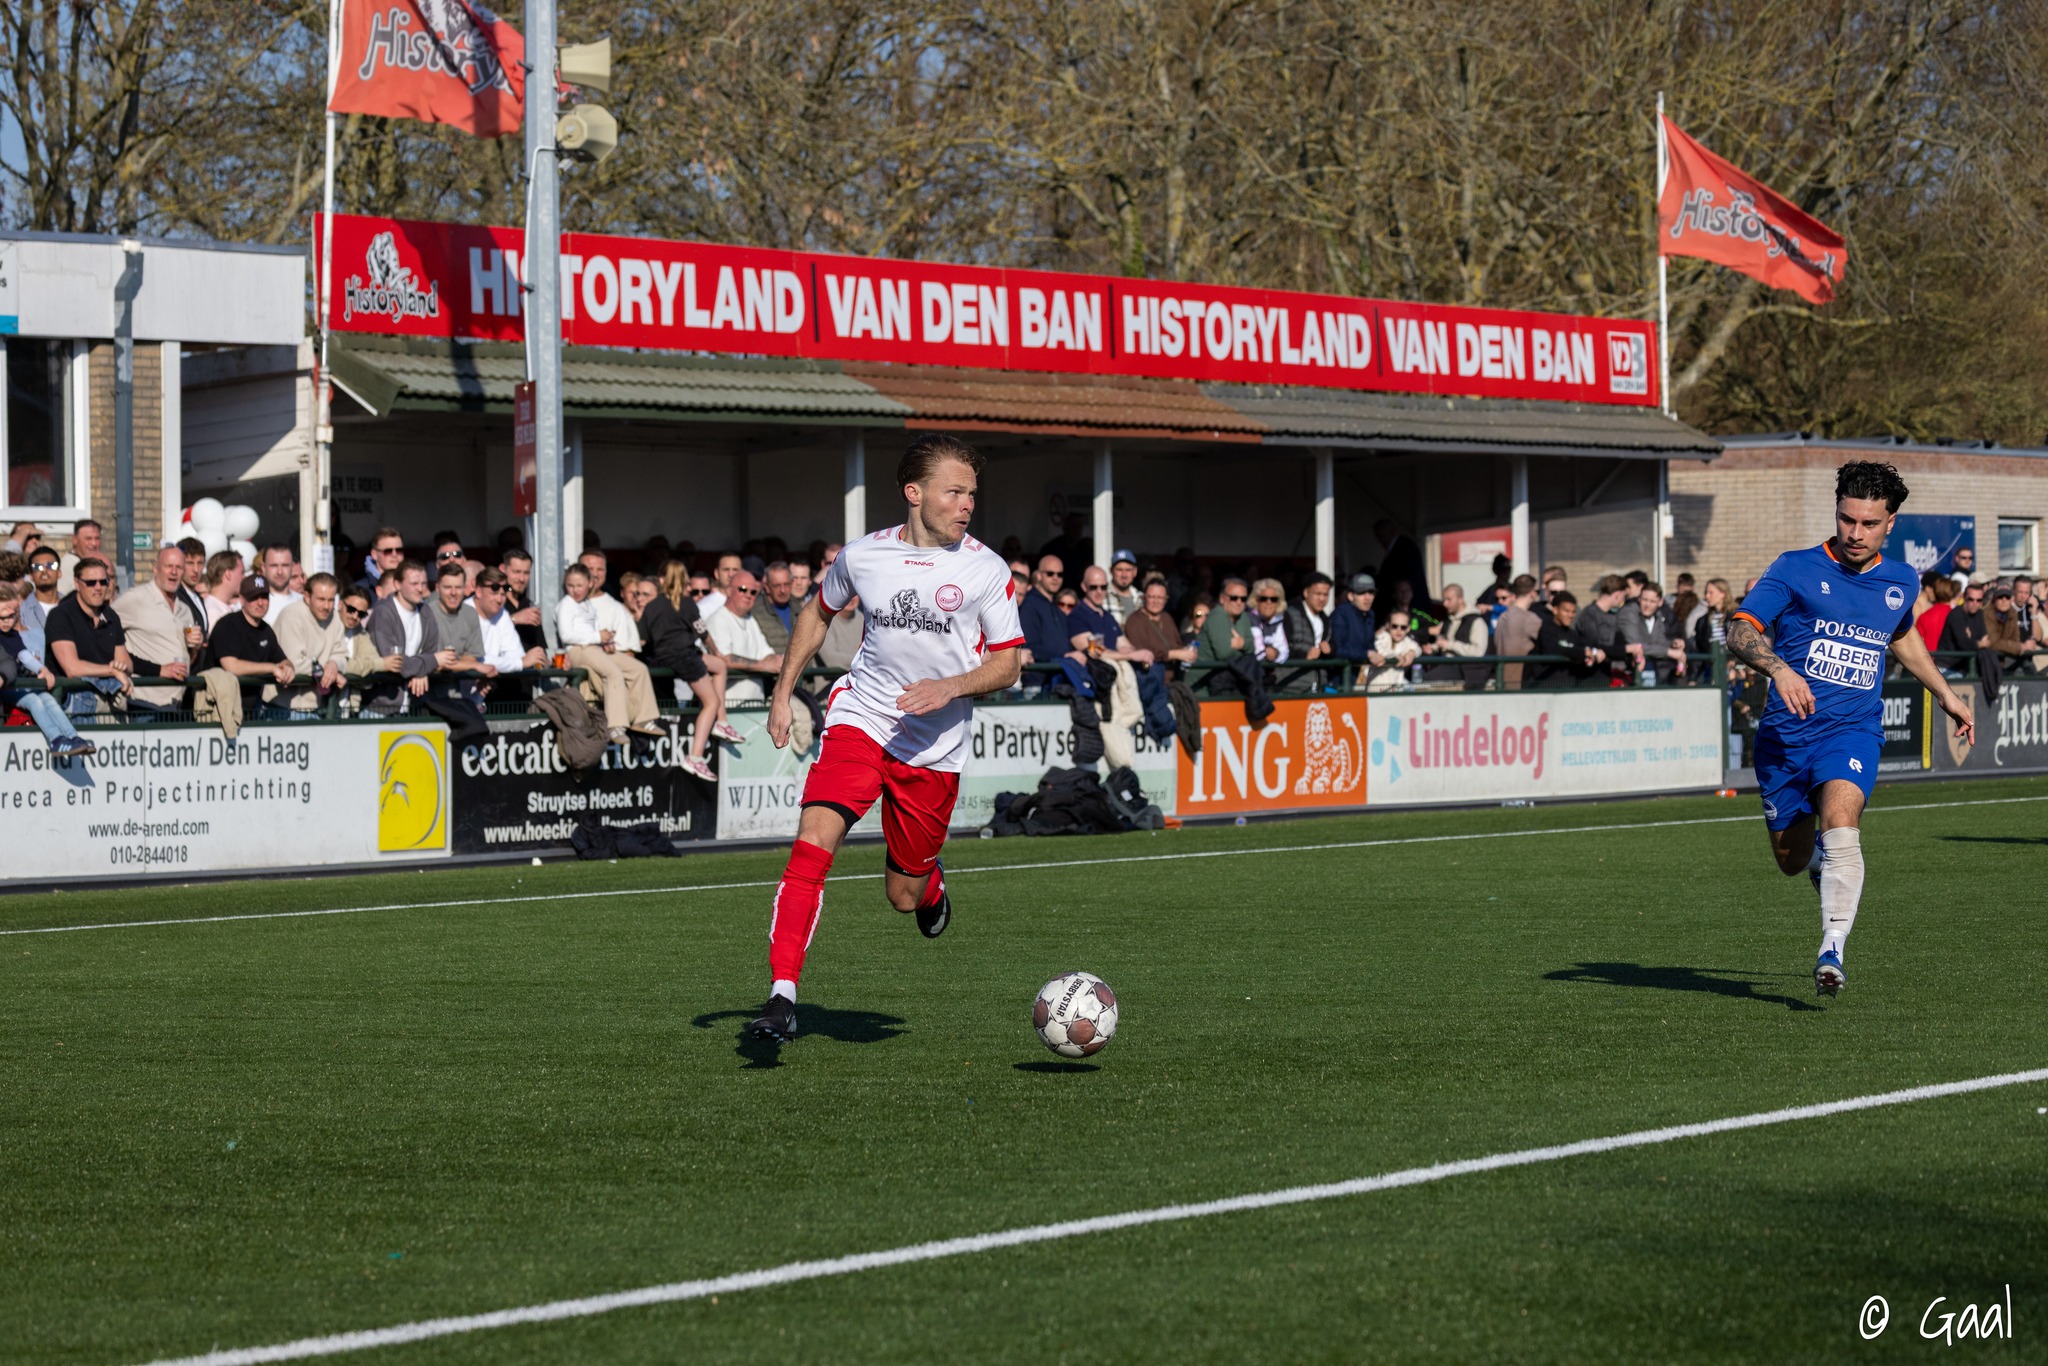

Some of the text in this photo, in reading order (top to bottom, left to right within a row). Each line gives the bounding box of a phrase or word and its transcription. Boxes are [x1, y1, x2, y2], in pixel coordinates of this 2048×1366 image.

[344, 274, 439, 323] Historyland
[469, 247, 805, 334] HITORYLAND
[824, 274, 1102, 351] VAN DEN BAN
[1122, 295, 1372, 369] HISTORYLAND
[1383, 317, 1595, 385] VAN DEN BAN
[904, 559, 934, 567] STANNO
[871, 608, 952, 635] Historyland
[1813, 641, 1879, 668] ALBERS
[1809, 658, 1875, 686] ZUIDLAND
[1619, 717, 1674, 735] WATERBOUW
[209, 737, 250, 766] Den
[257, 735, 310, 771] Haag
[994, 724, 1050, 766] Party
[1409, 712, 1549, 780] Lindeloof
[1561, 749, 1638, 767] HELLEVOETSLUIS
[1188, 722, 1291, 802] ING
[67, 787, 92, 805] en
[106, 777, 311, 810] Projectinrichting
[527, 786, 653, 815] Struytse Hoeck 16
[728, 784, 799, 815] WIJNG
[88, 818, 210, 838] www.de-arend.com
[110, 845, 188, 864] 010-2844018
[1056, 978, 1084, 1018] DERBYSTAR
